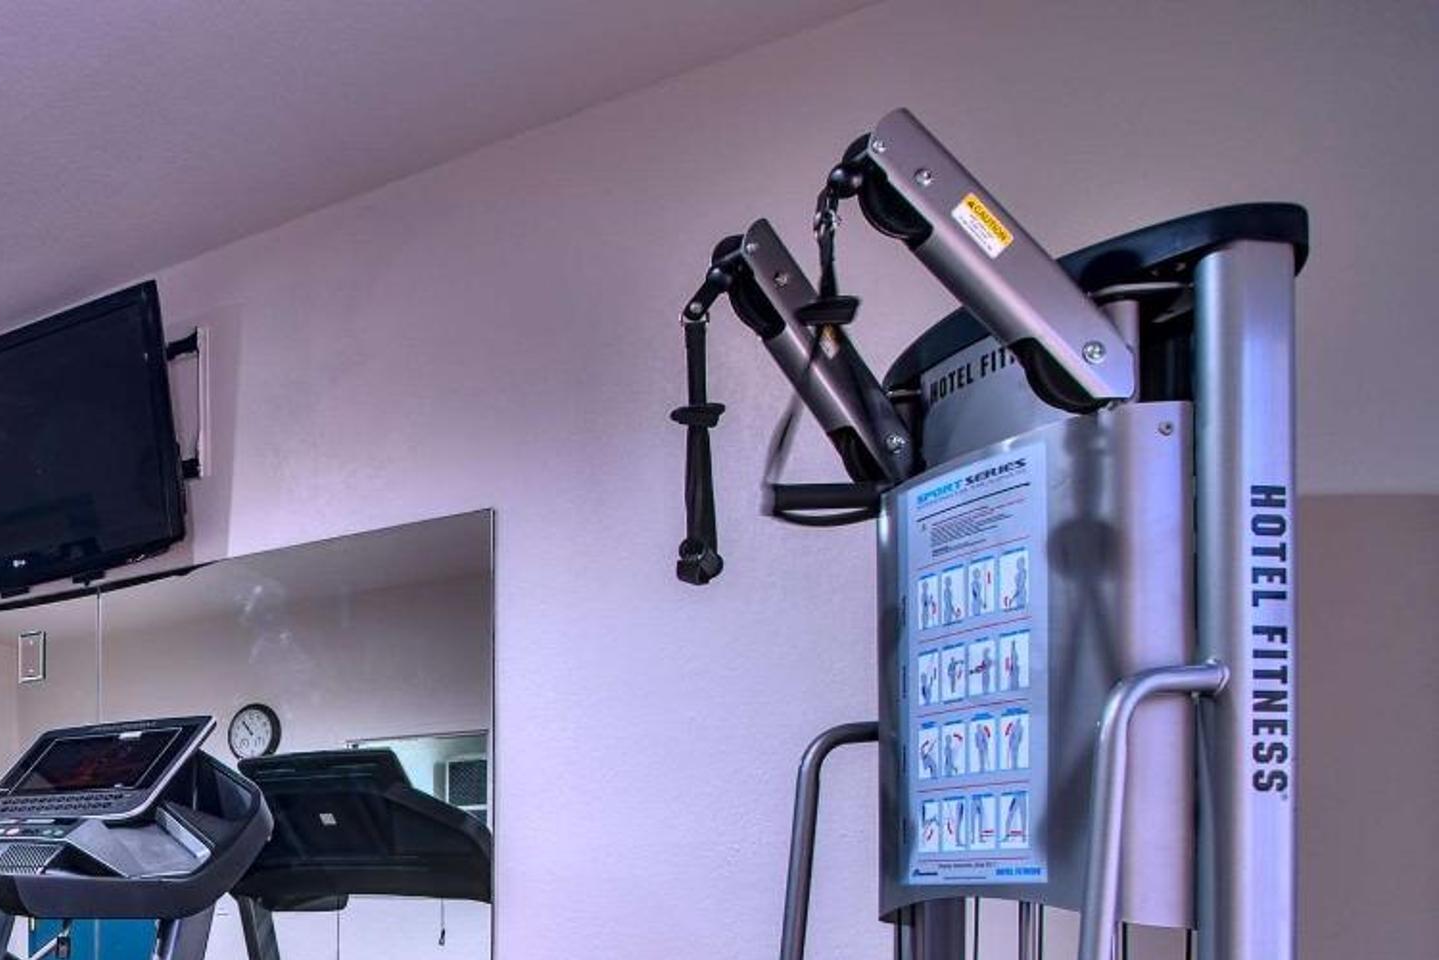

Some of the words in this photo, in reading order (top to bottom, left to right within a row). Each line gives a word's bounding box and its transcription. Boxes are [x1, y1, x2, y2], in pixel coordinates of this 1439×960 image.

[974, 204, 1008, 242] CAUTION
[929, 362, 974, 405] HOTEL
[981, 346, 1015, 378] FIT
[1250, 485, 1287, 607] HOTEL
[1252, 625, 1288, 793] FITNESS
